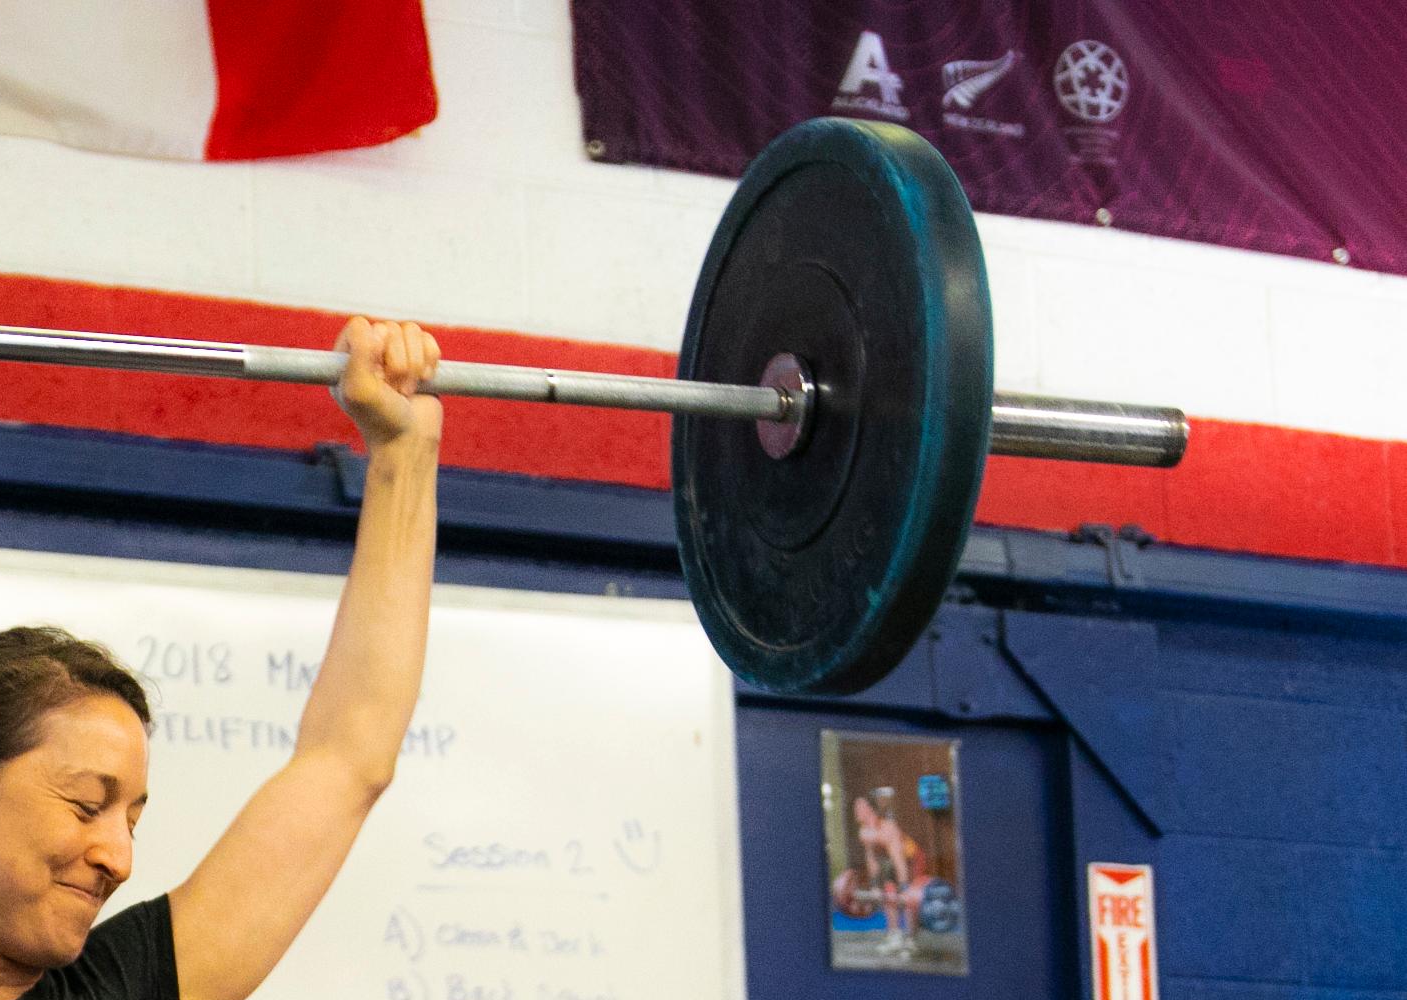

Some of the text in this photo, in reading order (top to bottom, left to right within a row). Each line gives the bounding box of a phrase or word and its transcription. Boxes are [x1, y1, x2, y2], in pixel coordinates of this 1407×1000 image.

[136, 635, 234, 686] 2018
[421, 832, 595, 876] Session 2
[1098, 894, 1143, 929] FIRE
